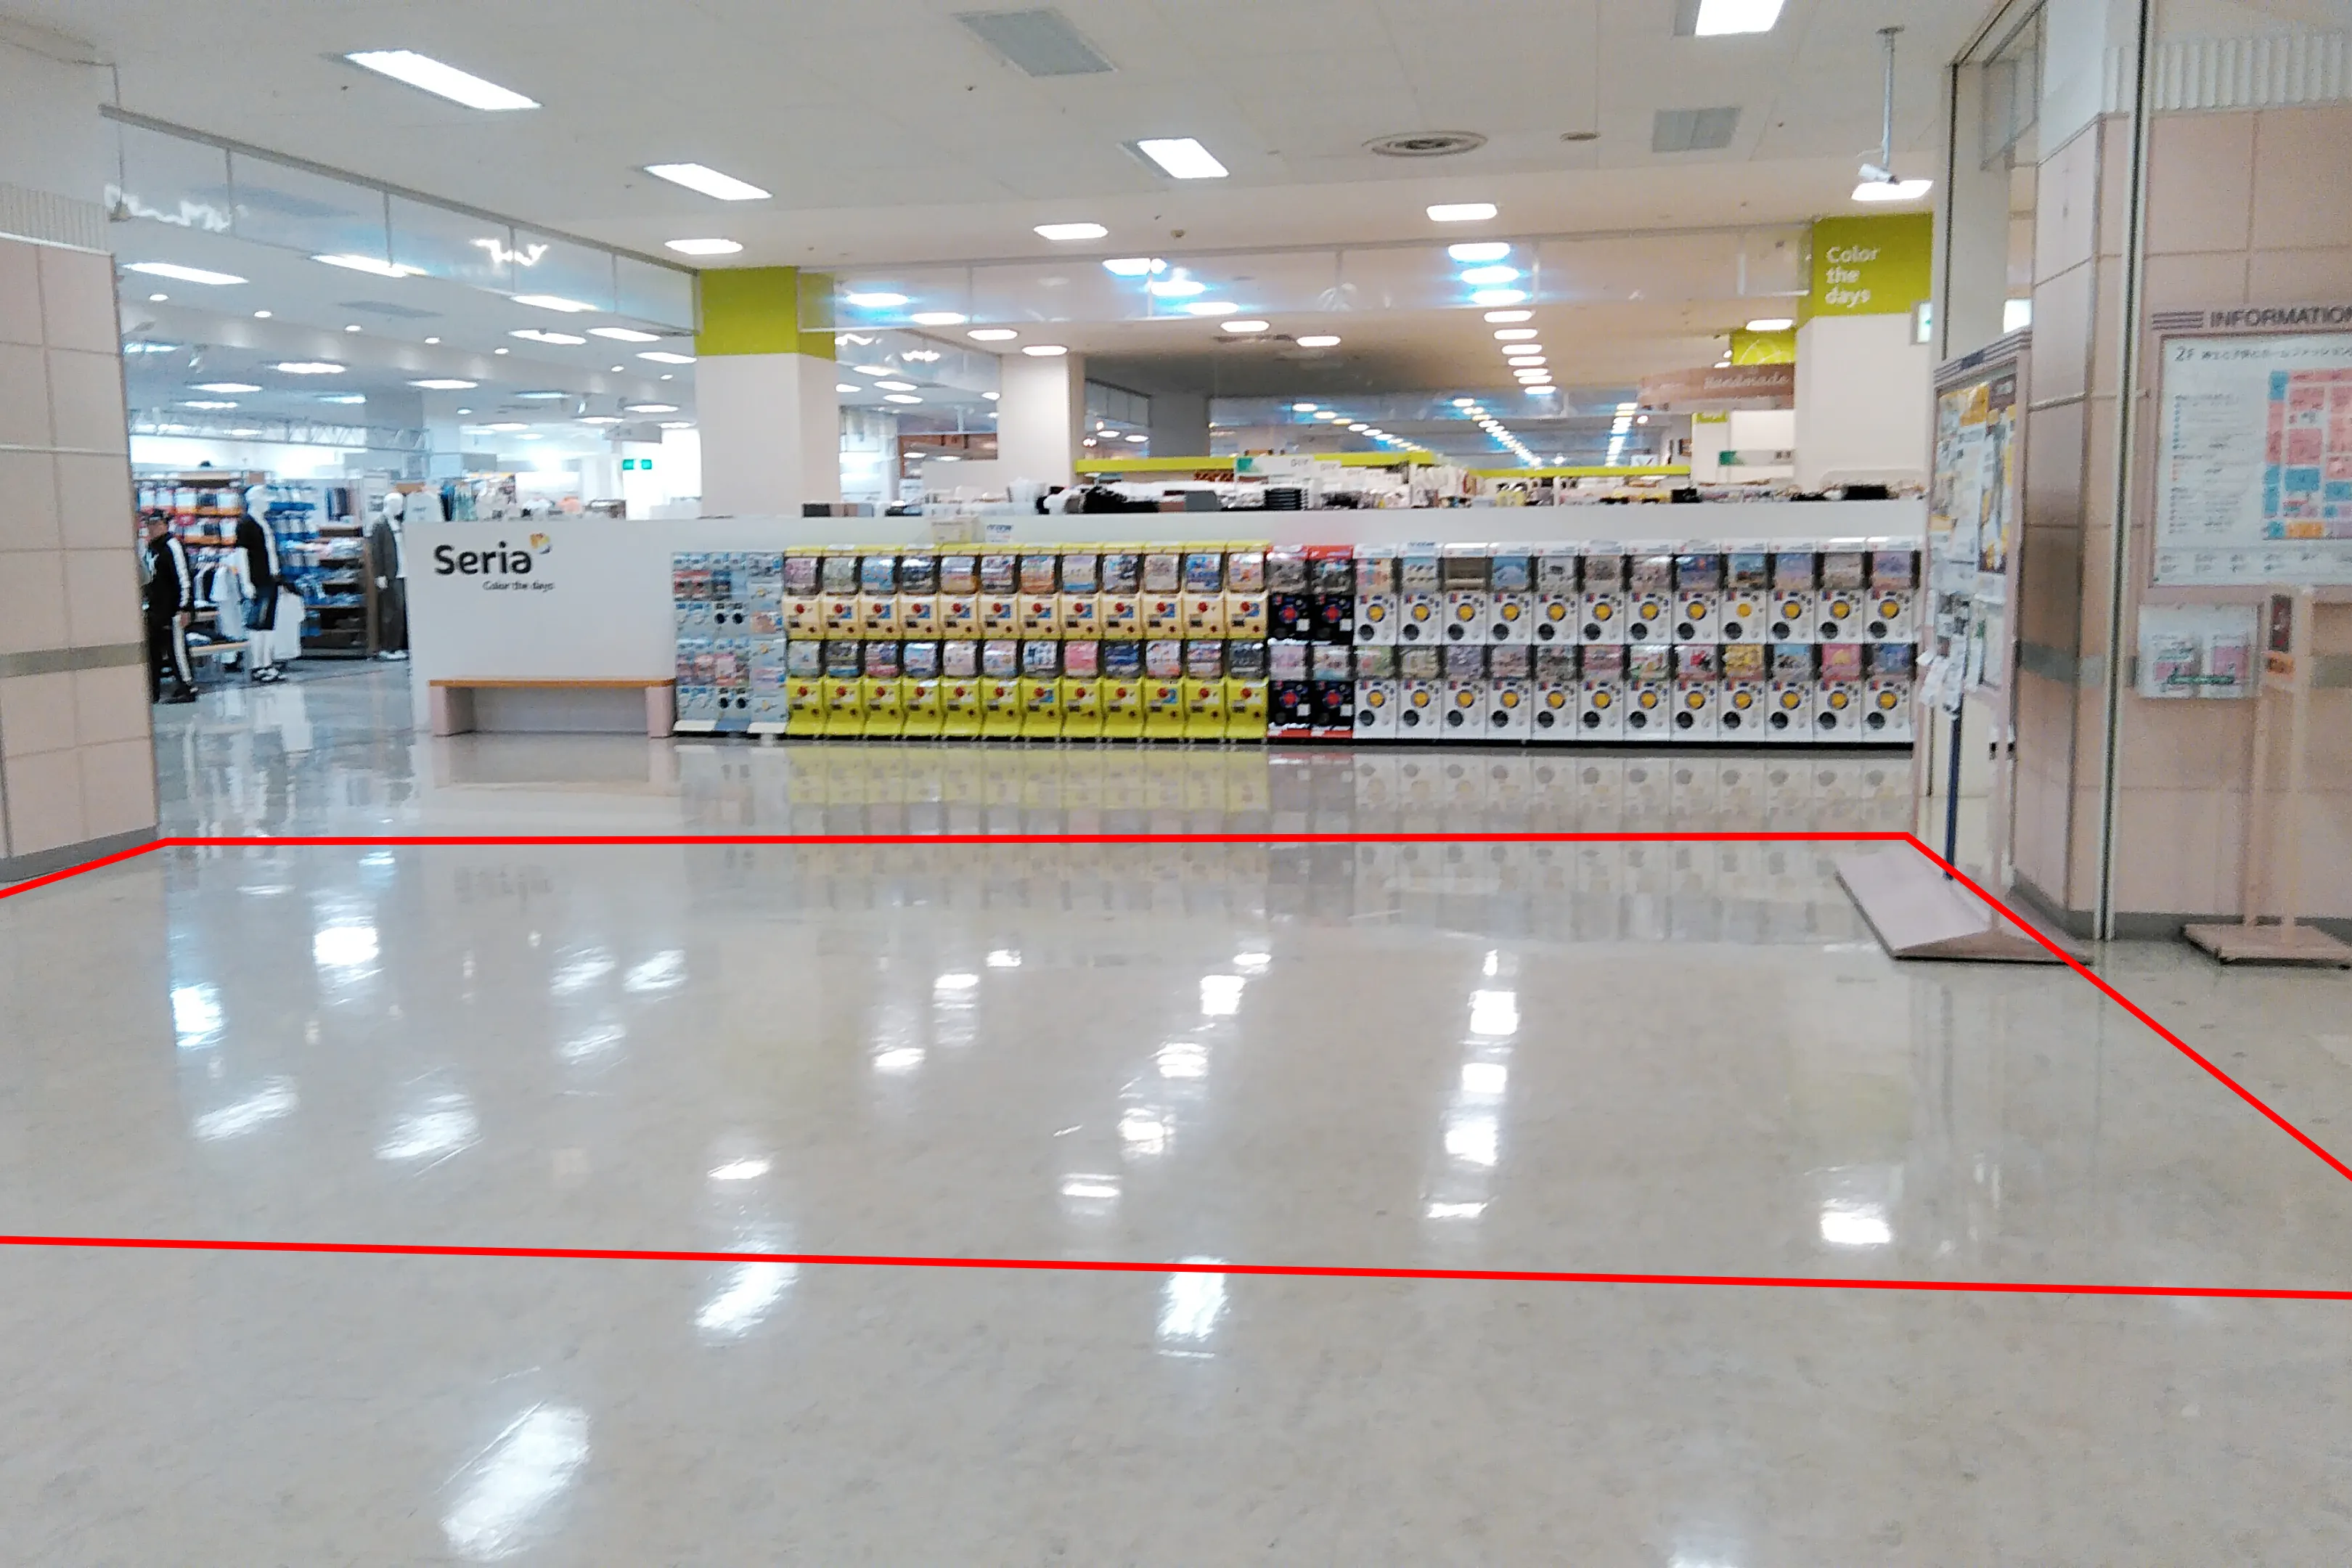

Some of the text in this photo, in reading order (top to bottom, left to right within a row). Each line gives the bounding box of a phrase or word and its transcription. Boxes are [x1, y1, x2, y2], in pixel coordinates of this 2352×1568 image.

[1826, 246, 1881, 264] Color
[1826, 266, 1860, 284] the
[1825, 285, 1871, 309] days
[434, 541, 532, 575] Seria
